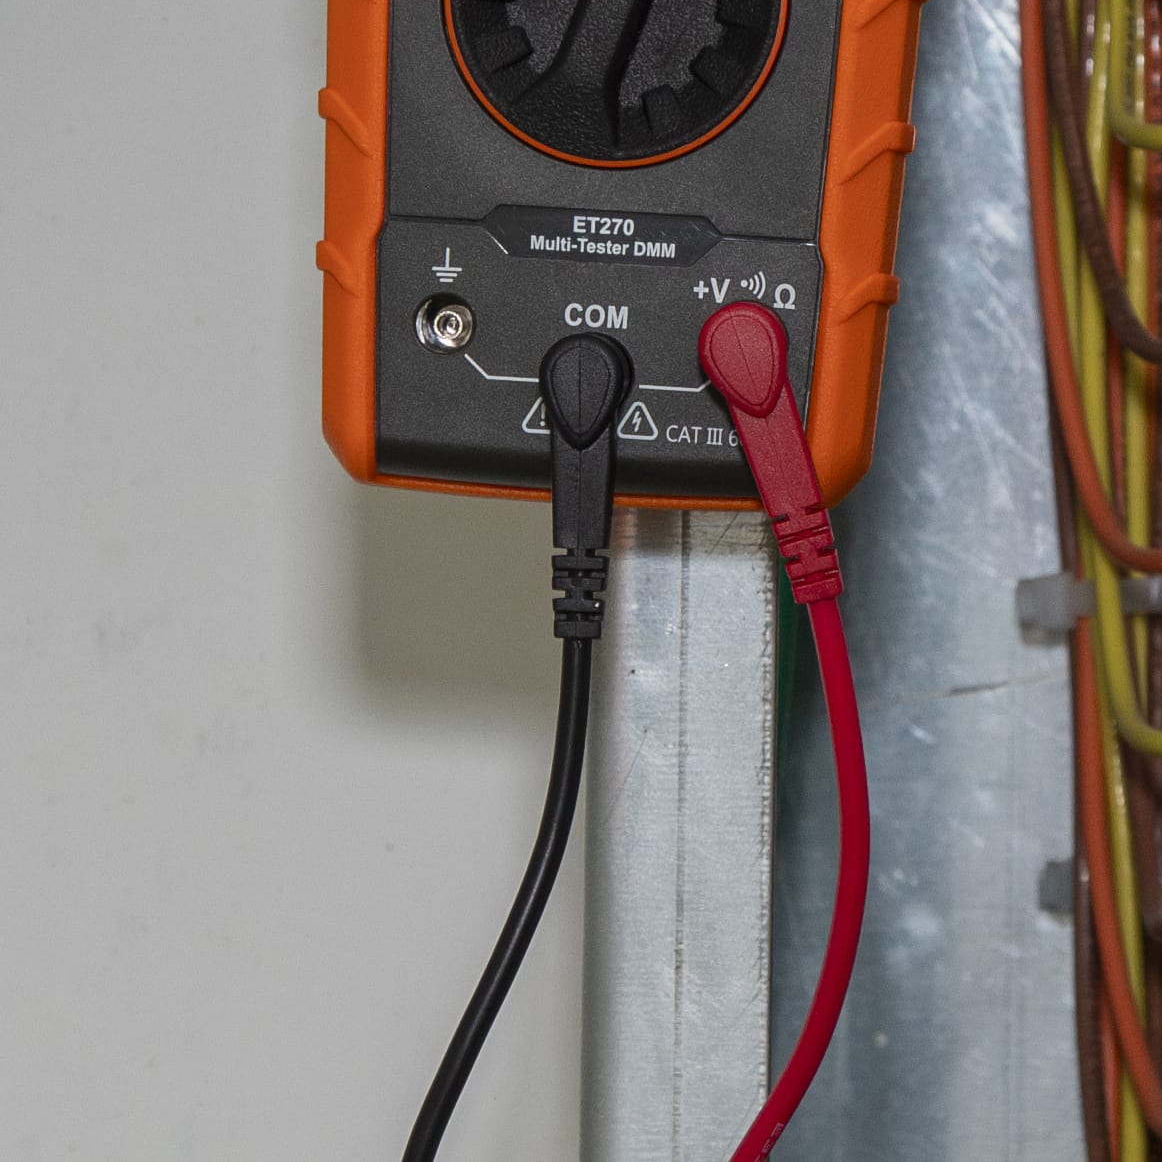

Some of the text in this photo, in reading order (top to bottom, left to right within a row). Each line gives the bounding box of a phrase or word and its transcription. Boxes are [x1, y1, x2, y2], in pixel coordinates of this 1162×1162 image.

[572, 216, 635, 236] ET270
[529, 236, 676, 259] Multi-Tester DMM
[564, 303, 629, 329] COM
[666, 424, 702, 444] CAT
